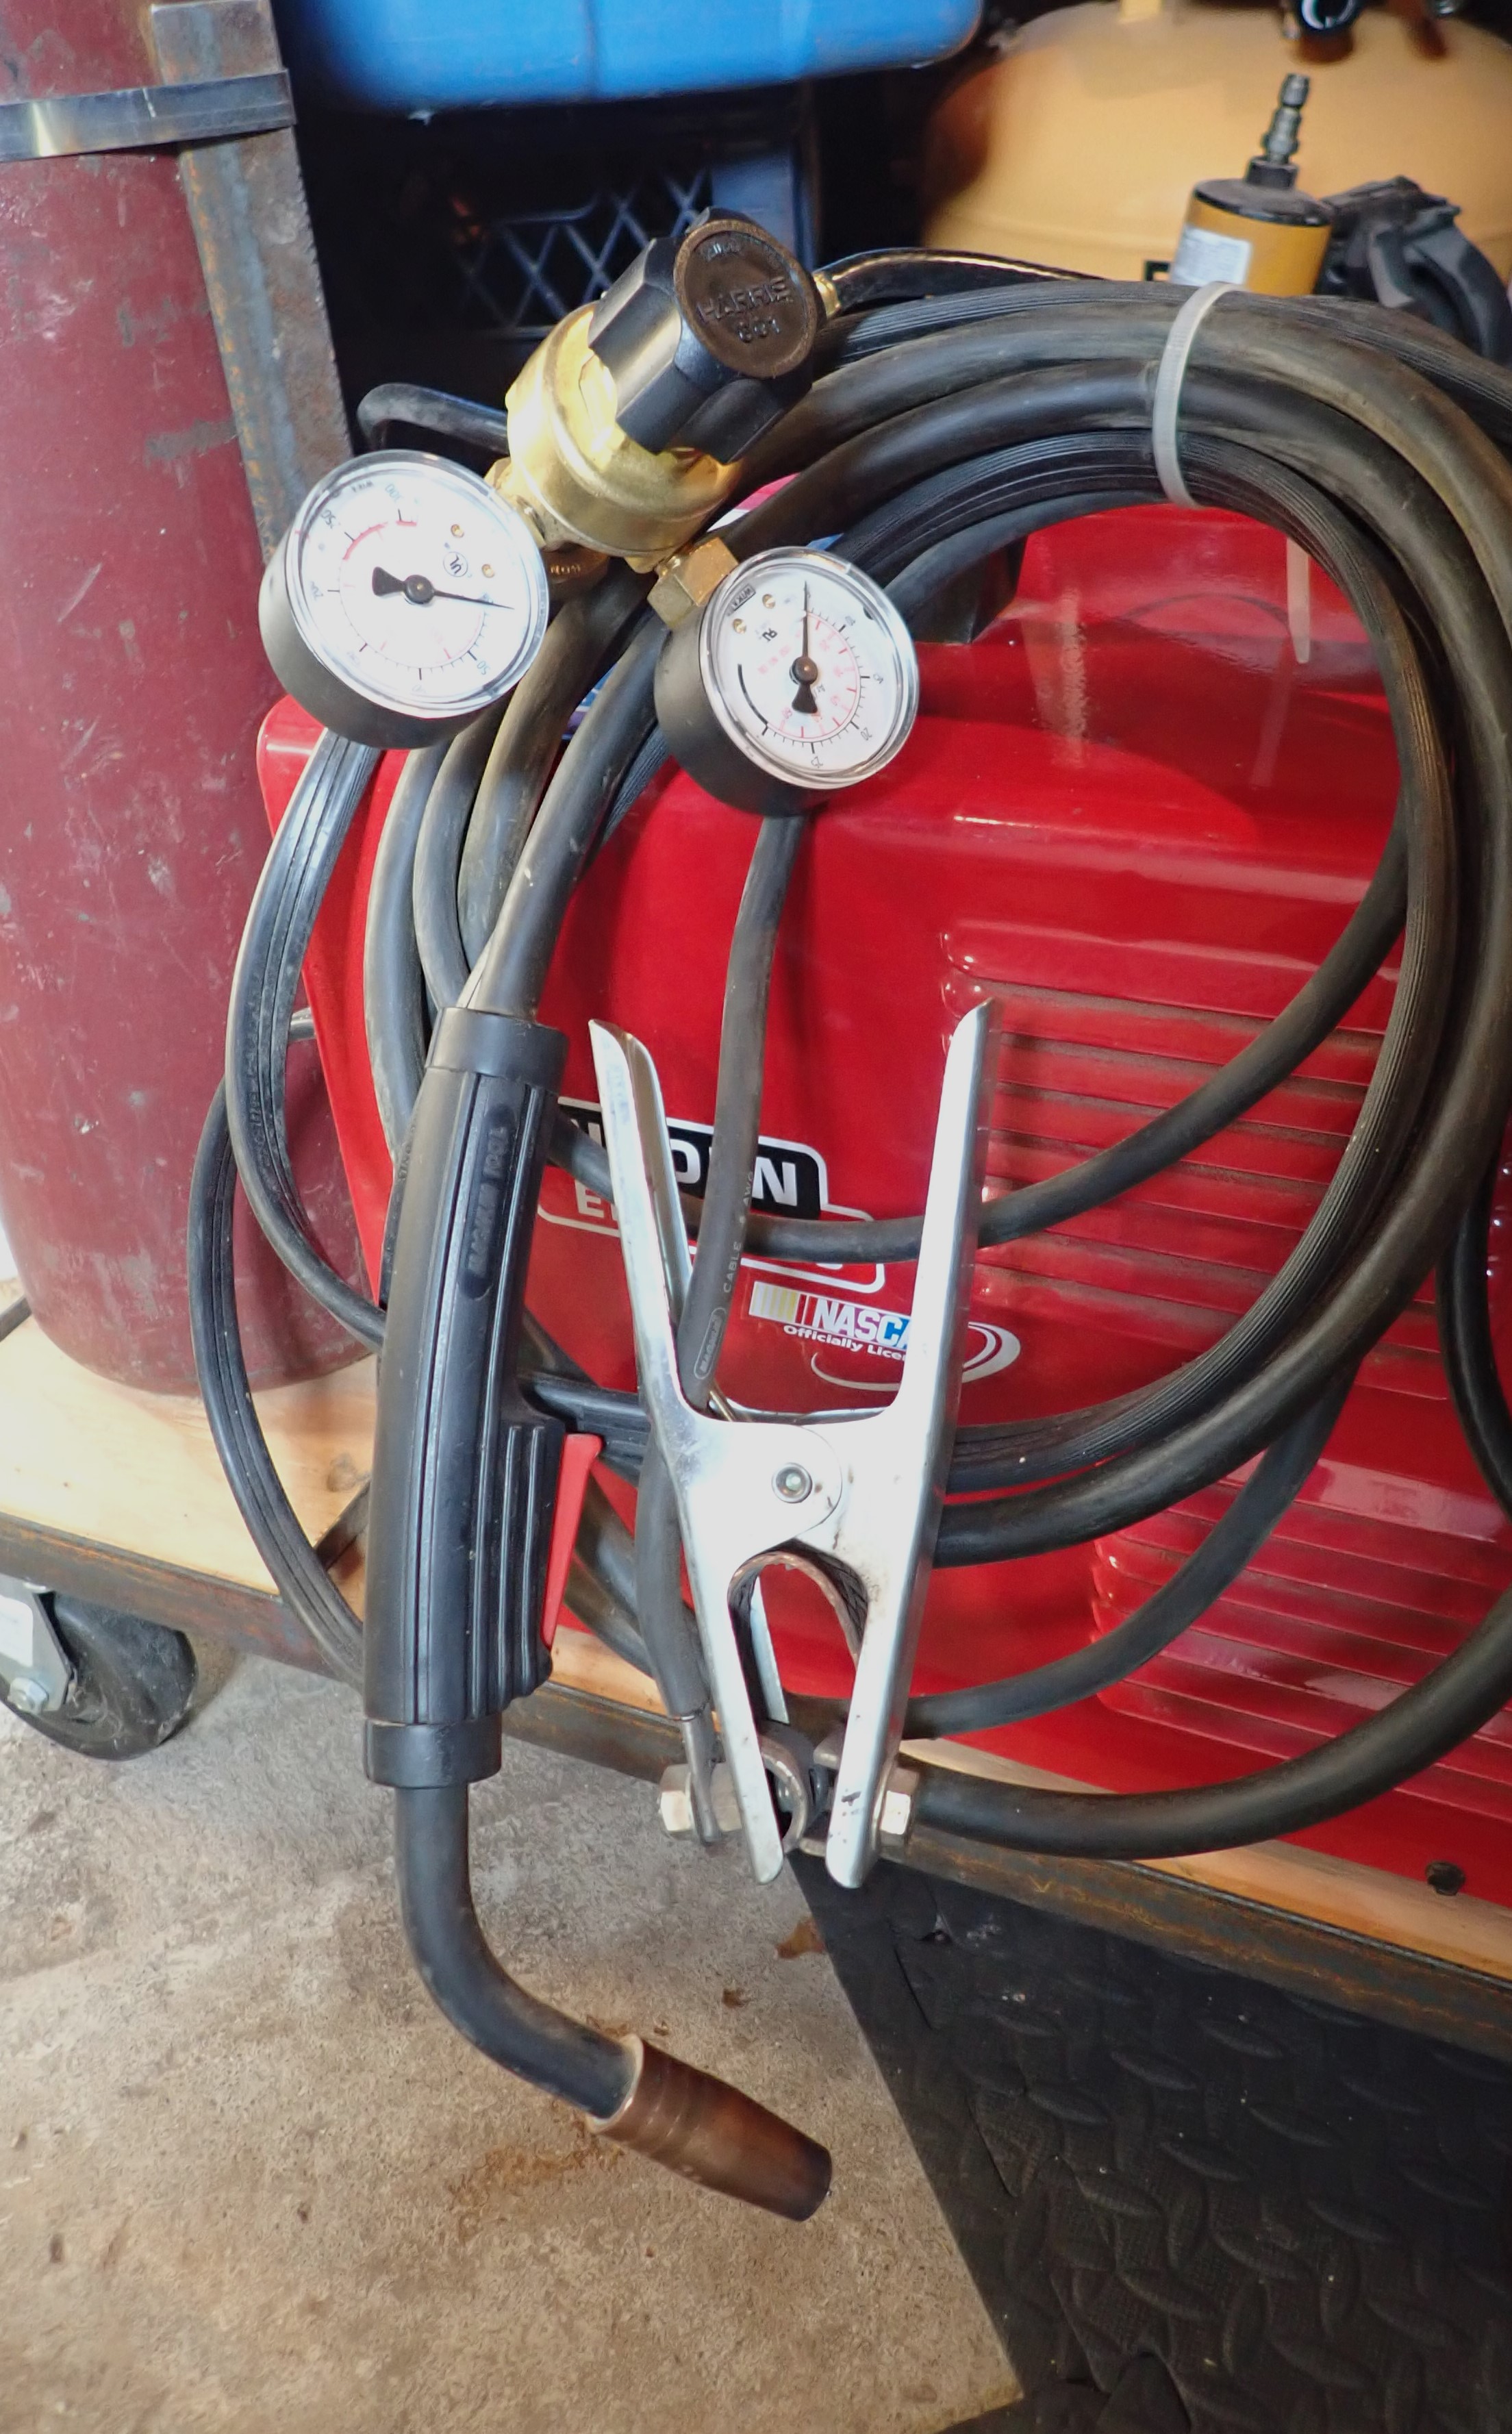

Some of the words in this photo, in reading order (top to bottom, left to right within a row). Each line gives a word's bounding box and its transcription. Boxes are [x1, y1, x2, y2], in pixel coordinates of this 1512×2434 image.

[696, 275, 793, 325] HARRIS
[860, 727, 872, 741] 20
[723, 1242, 742, 1294] CABLE
[783, 1325, 864, 1352] Officially
[867, 1344, 905, 1362] Lice
